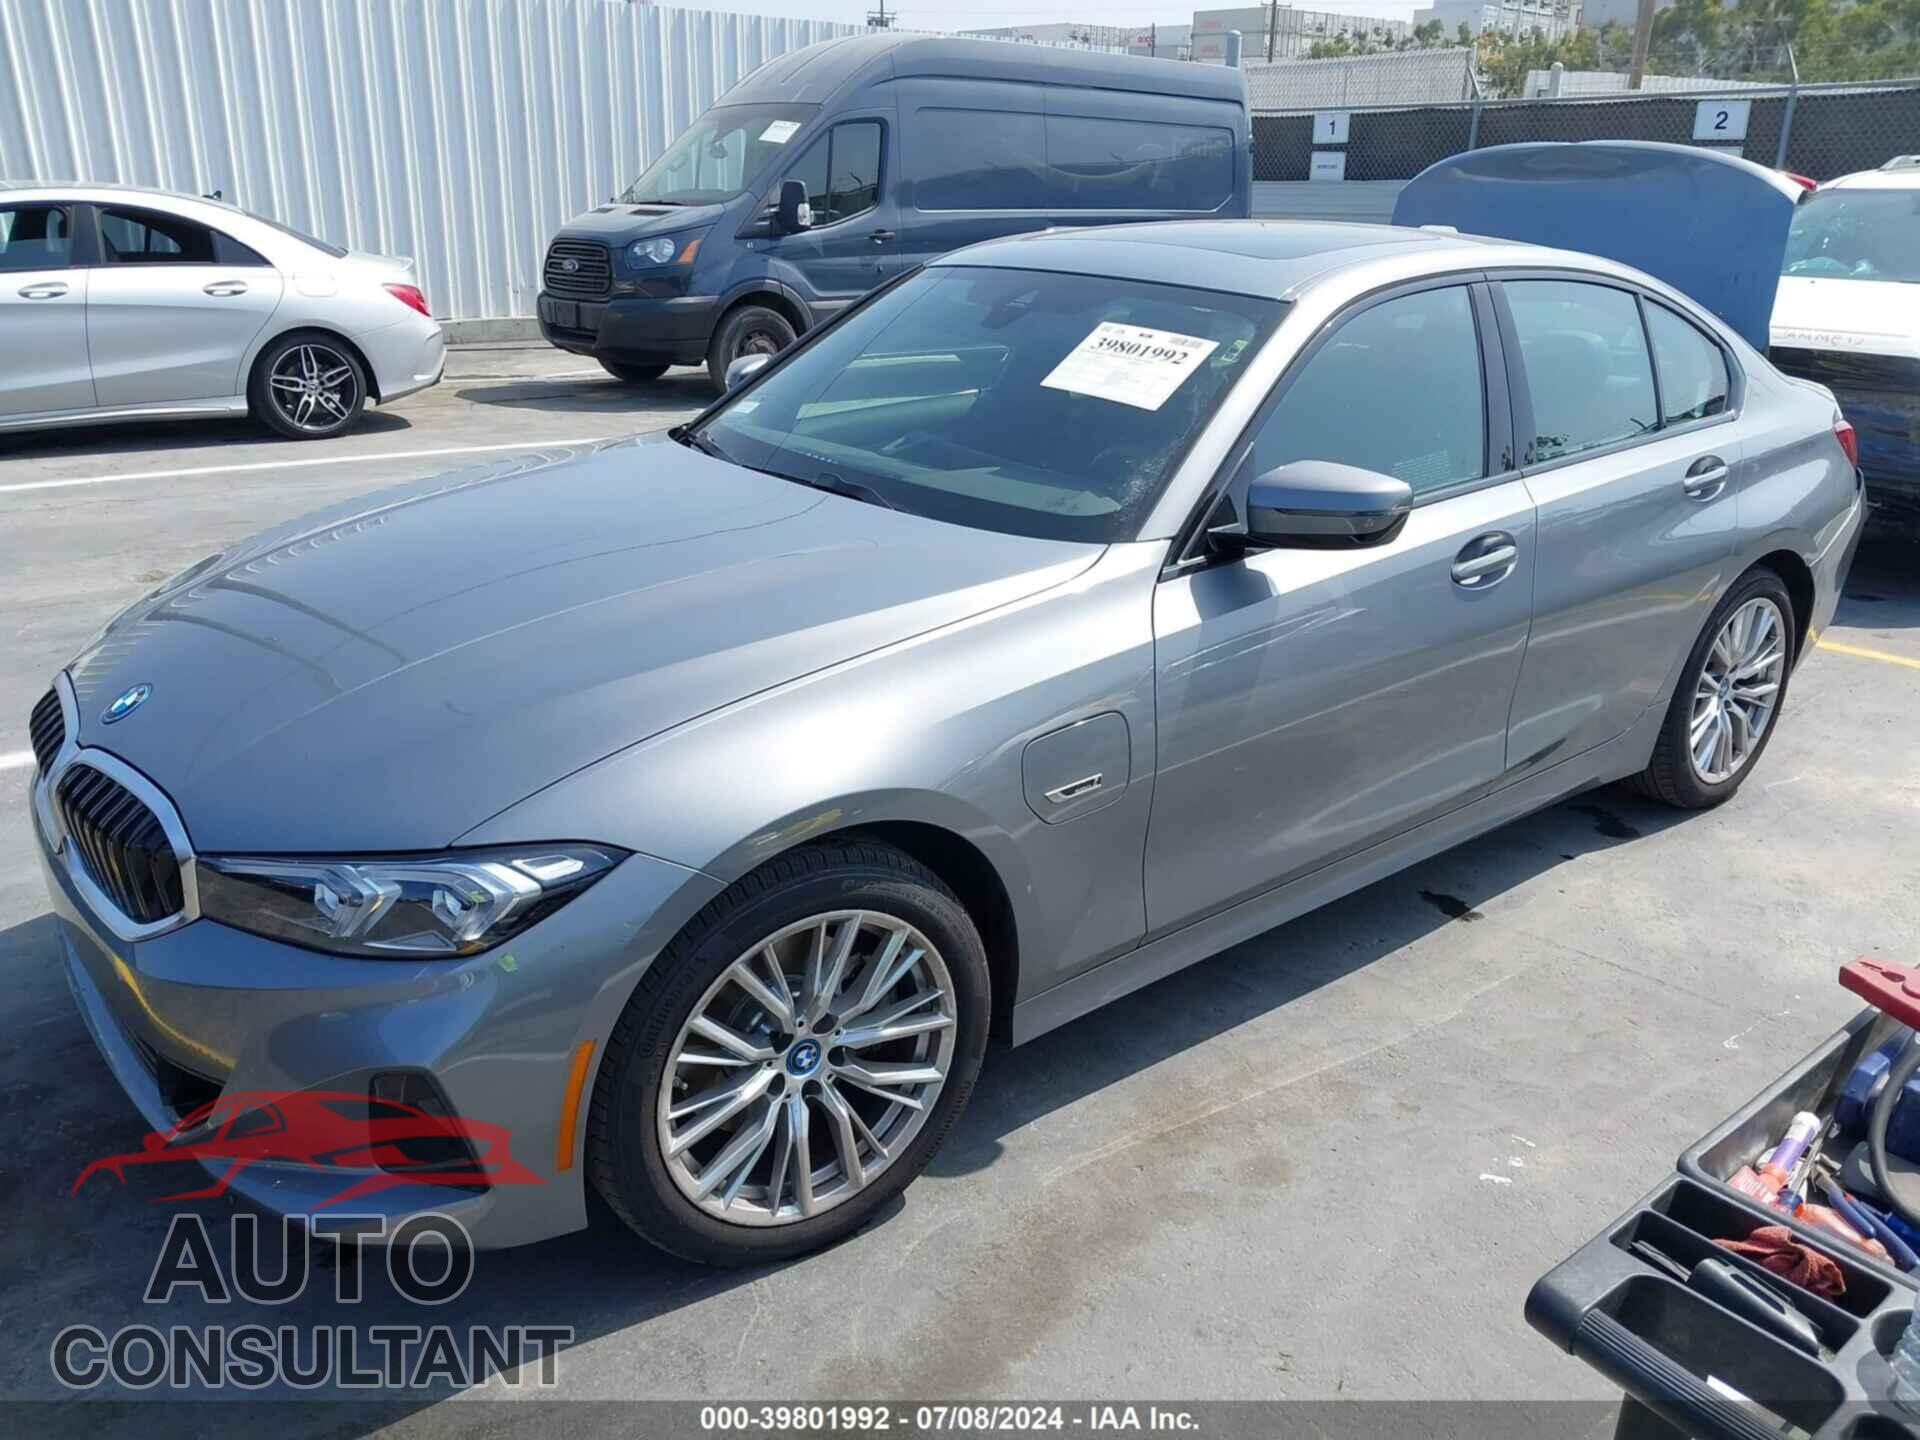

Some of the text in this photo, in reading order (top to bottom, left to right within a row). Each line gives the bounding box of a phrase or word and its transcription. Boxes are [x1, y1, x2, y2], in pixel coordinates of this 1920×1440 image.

[1328, 119, 1336, 136] 1
[1713, 110, 1729, 130] 2
[1090, 336, 1189, 365] 39801992
